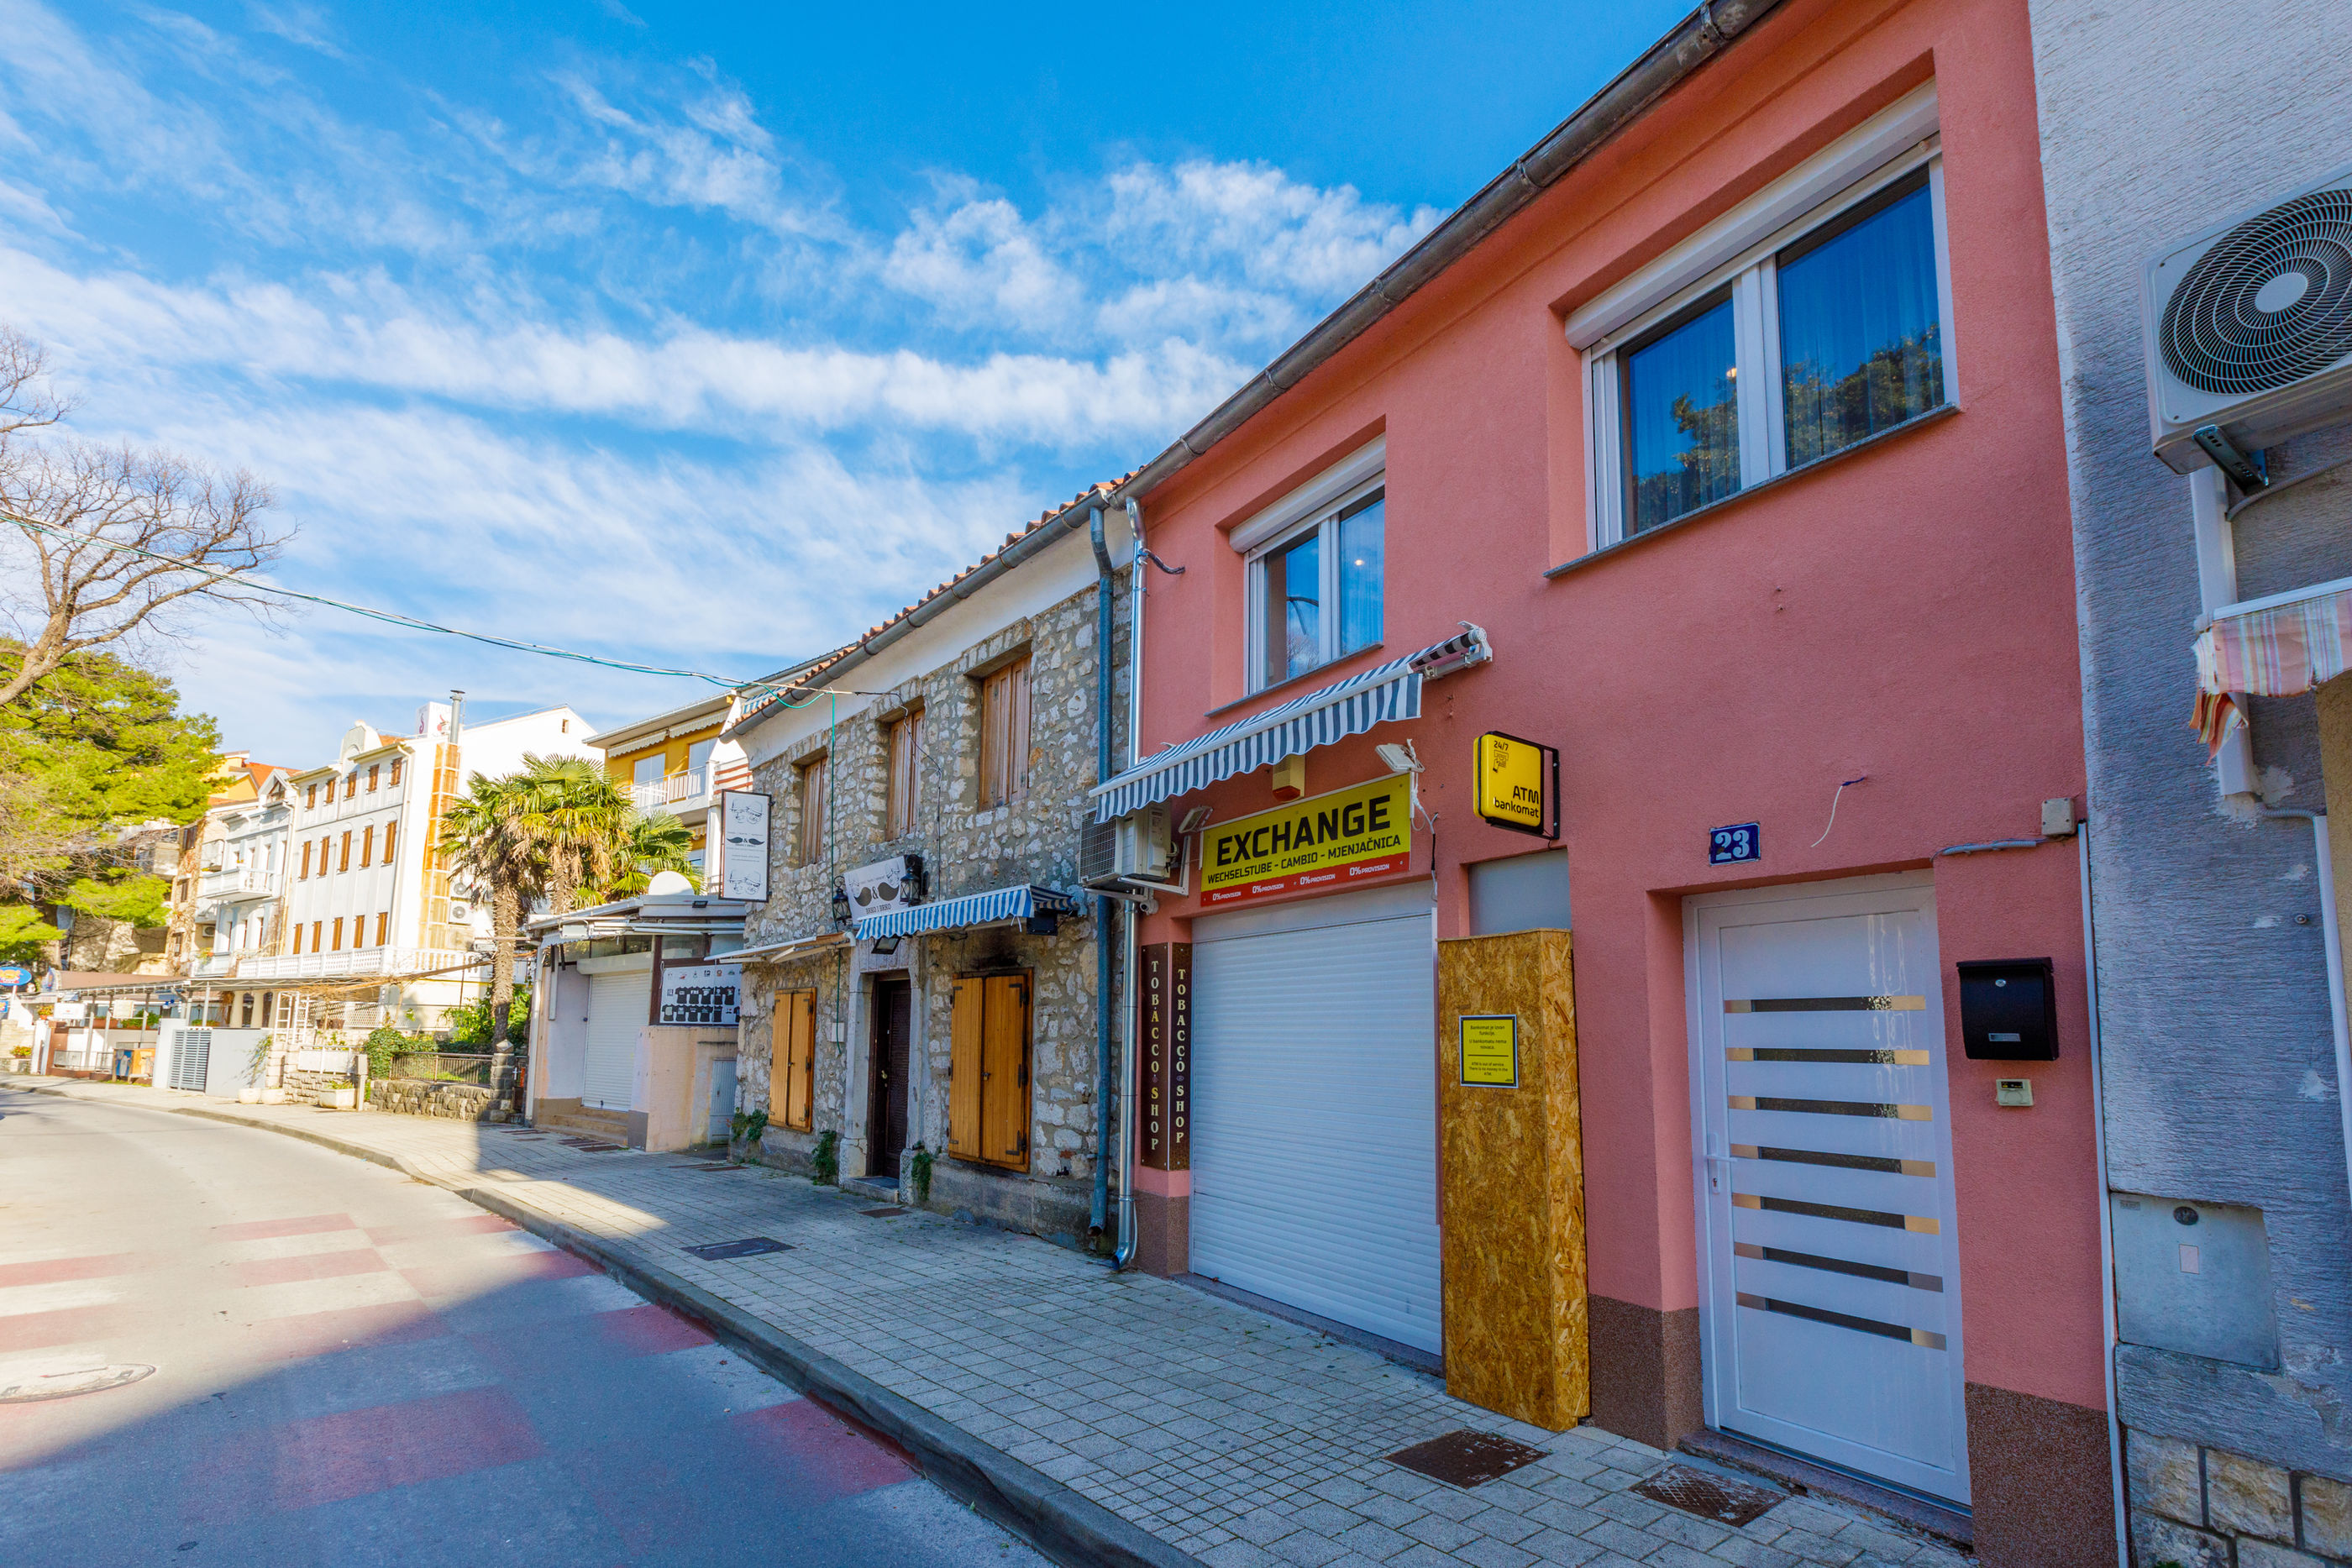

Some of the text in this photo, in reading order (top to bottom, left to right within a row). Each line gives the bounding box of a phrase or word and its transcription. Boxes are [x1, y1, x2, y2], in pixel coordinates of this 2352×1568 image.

[1494, 740, 1509, 751] 24/7
[1494, 797, 1539, 818] bankomat
[1513, 785, 1539, 805] ATM
[1217, 794, 1391, 867] EXCHANGE
[1714, 829, 1750, 861] 23
[1208, 862, 1272, 884] WECHSELSTUBE
[1281, 852, 1318, 869] CAMBIO
[1328, 834, 1401, 860] MJENJAČNICA
[1299, 876, 1310, 885] 0%
[1349, 867, 1361, 876] 0%
[1361, 863, 1389, 873] PROVISION
[1151, 960, 1159, 1151] TOBACCO SHOP
[1175, 968, 1186, 1143] TOBACCO SHOP
